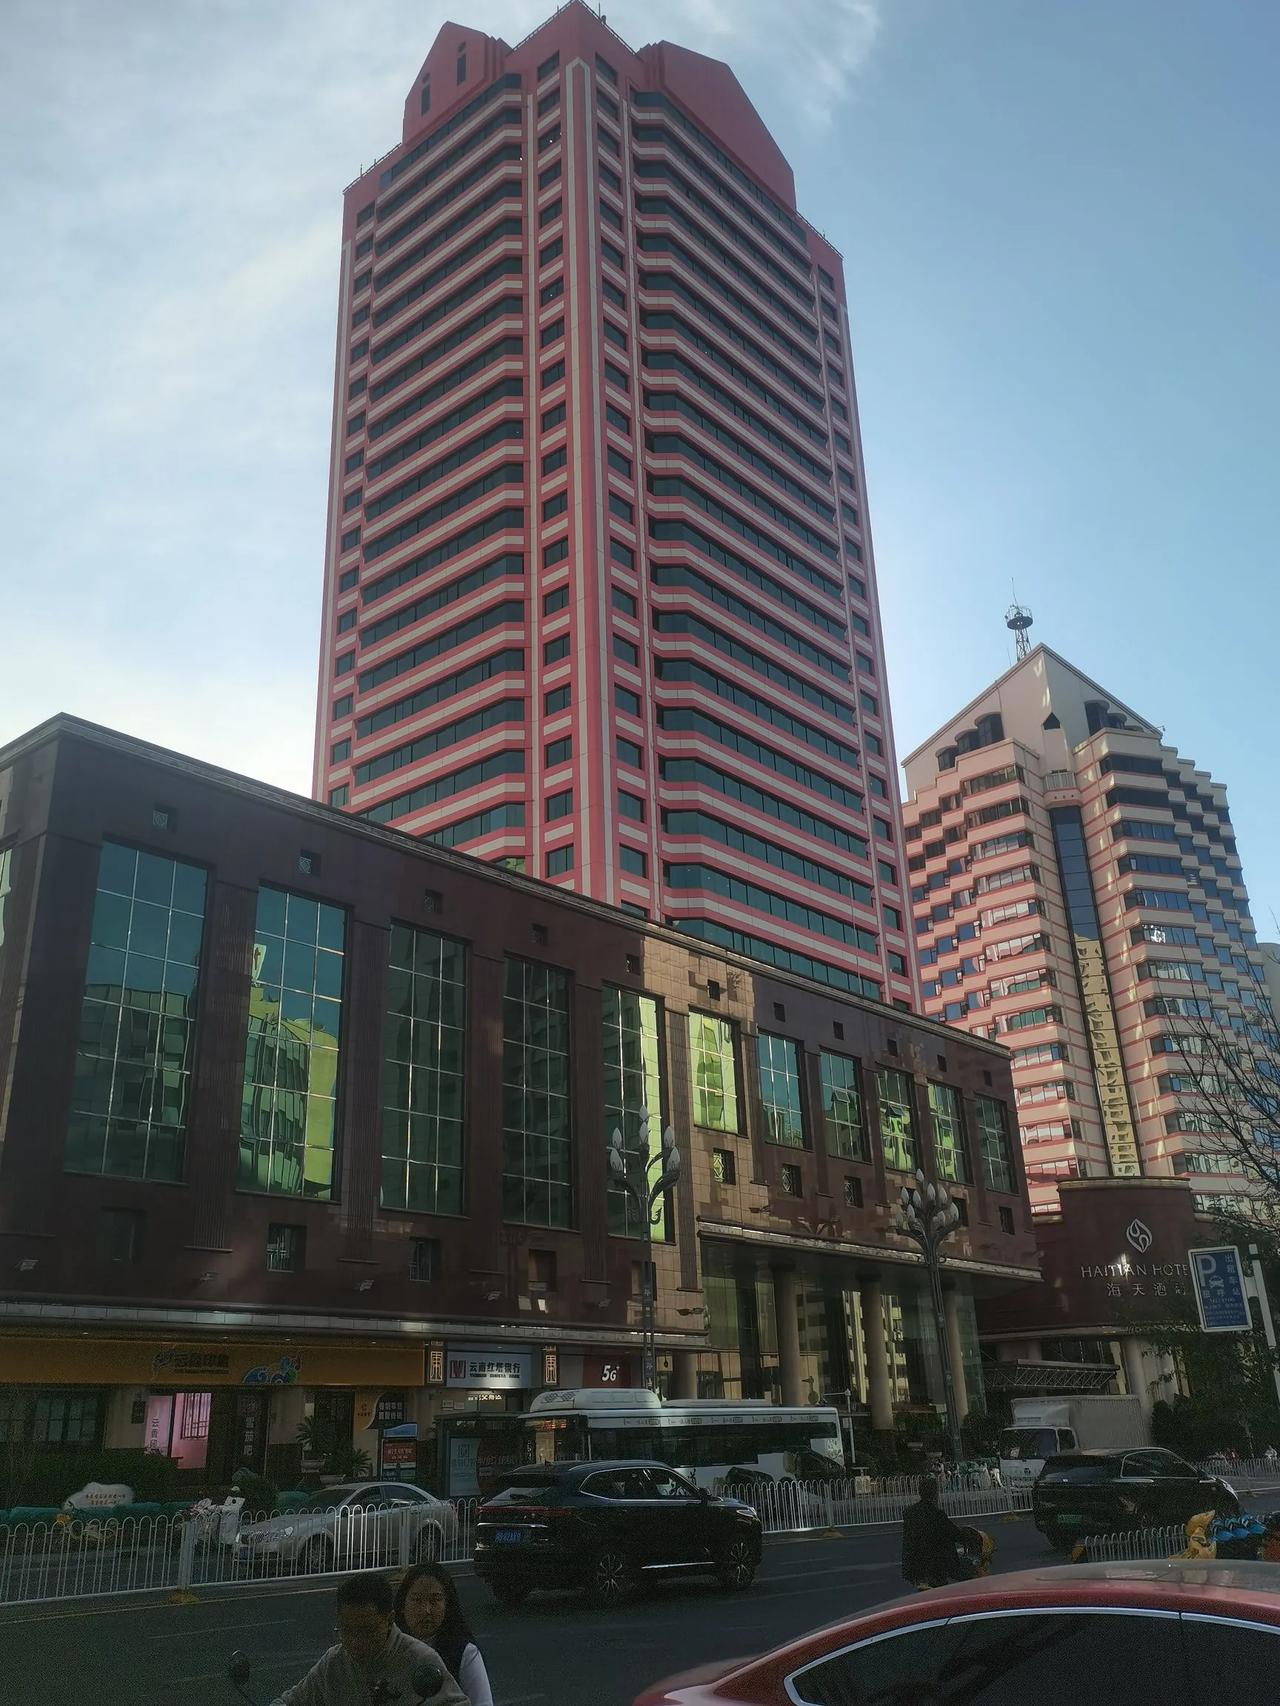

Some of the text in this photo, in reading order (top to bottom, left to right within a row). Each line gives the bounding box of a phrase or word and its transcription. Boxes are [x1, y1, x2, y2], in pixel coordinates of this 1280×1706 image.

[1080, 1263, 1189, 1278] HAITIAN HOTE
[1196, 1254, 1217, 1287] P
[469, 1361, 521, 1373] 云南红塔银行
